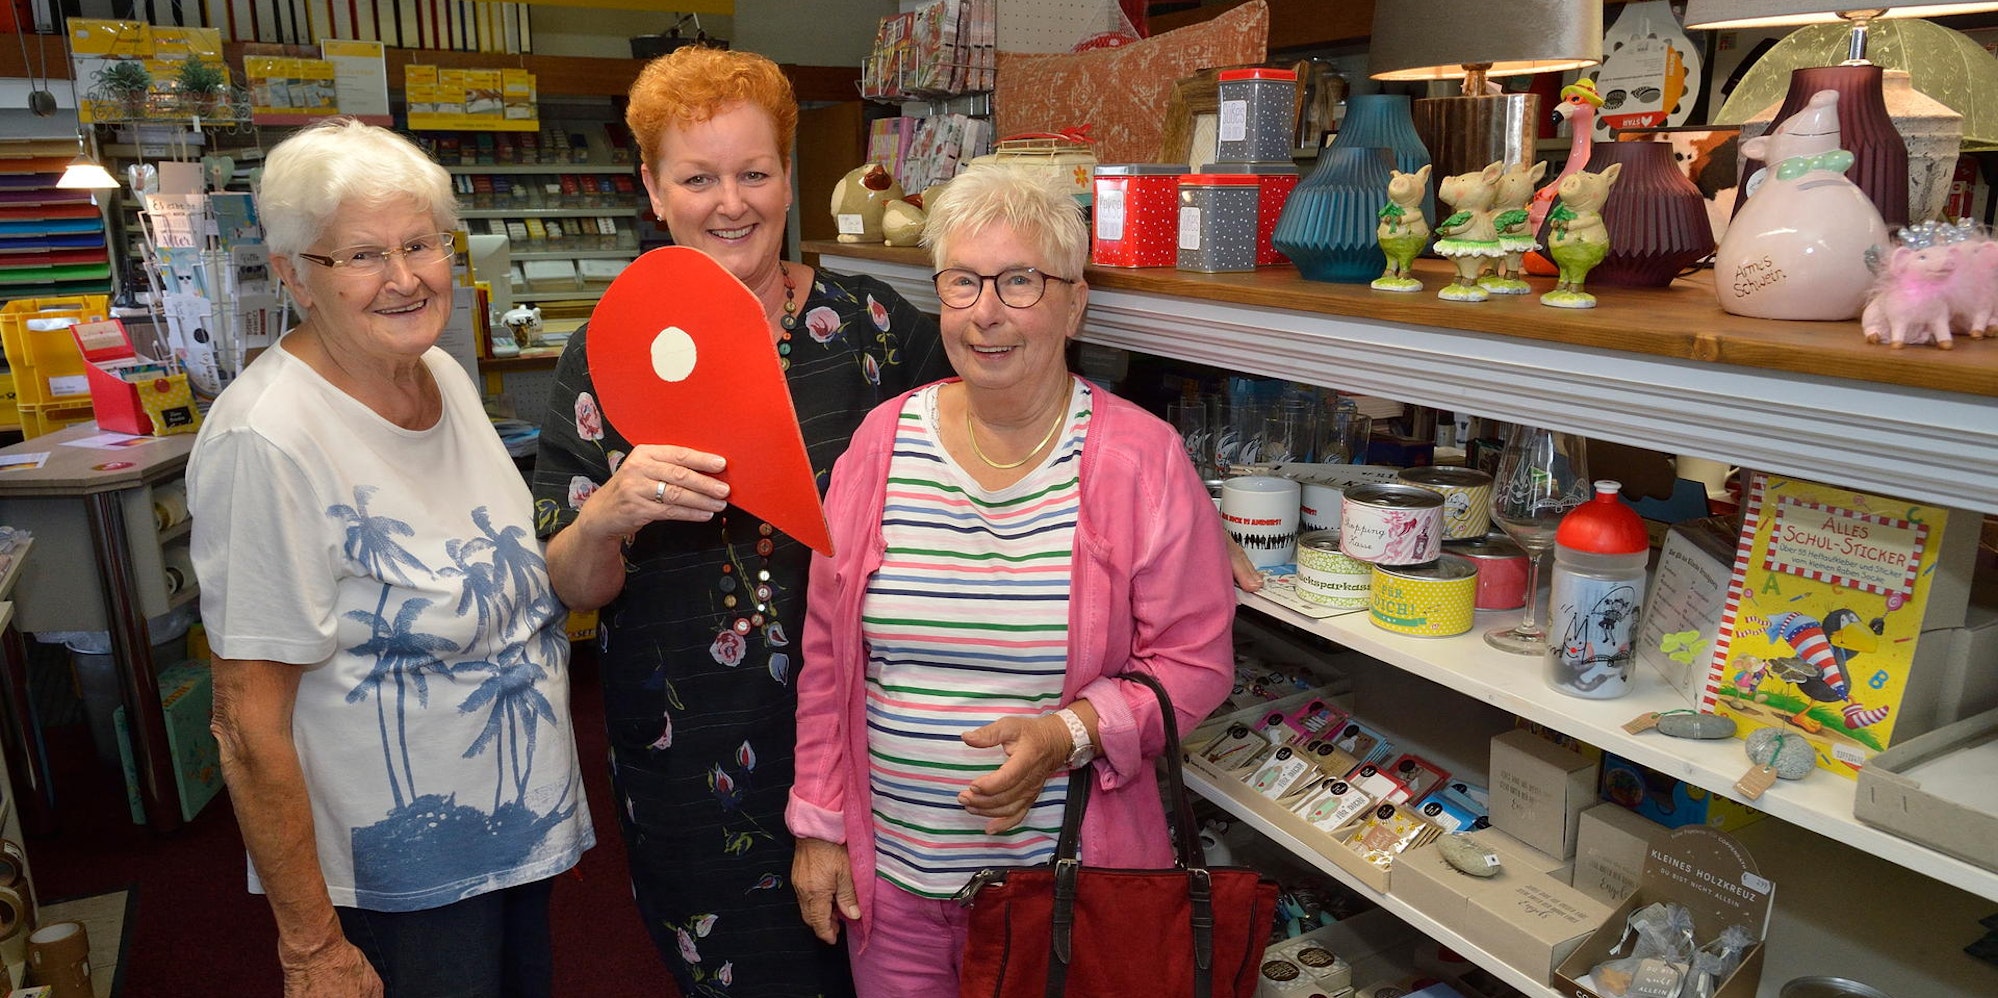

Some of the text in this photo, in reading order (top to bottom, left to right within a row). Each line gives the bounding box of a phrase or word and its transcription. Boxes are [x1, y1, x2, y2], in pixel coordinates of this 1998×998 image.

[1735, 255, 1773, 281] Armes
[1821, 517, 1869, 539] ALLES
[1374, 593, 1416, 616] DICH!
[1650, 849, 1692, 874] KLEINES
[1696, 868, 1757, 903] HOLZKREUZ
[1690, 881, 1713, 895] NICHT
[1714, 892, 1740, 908] ALLEIN
